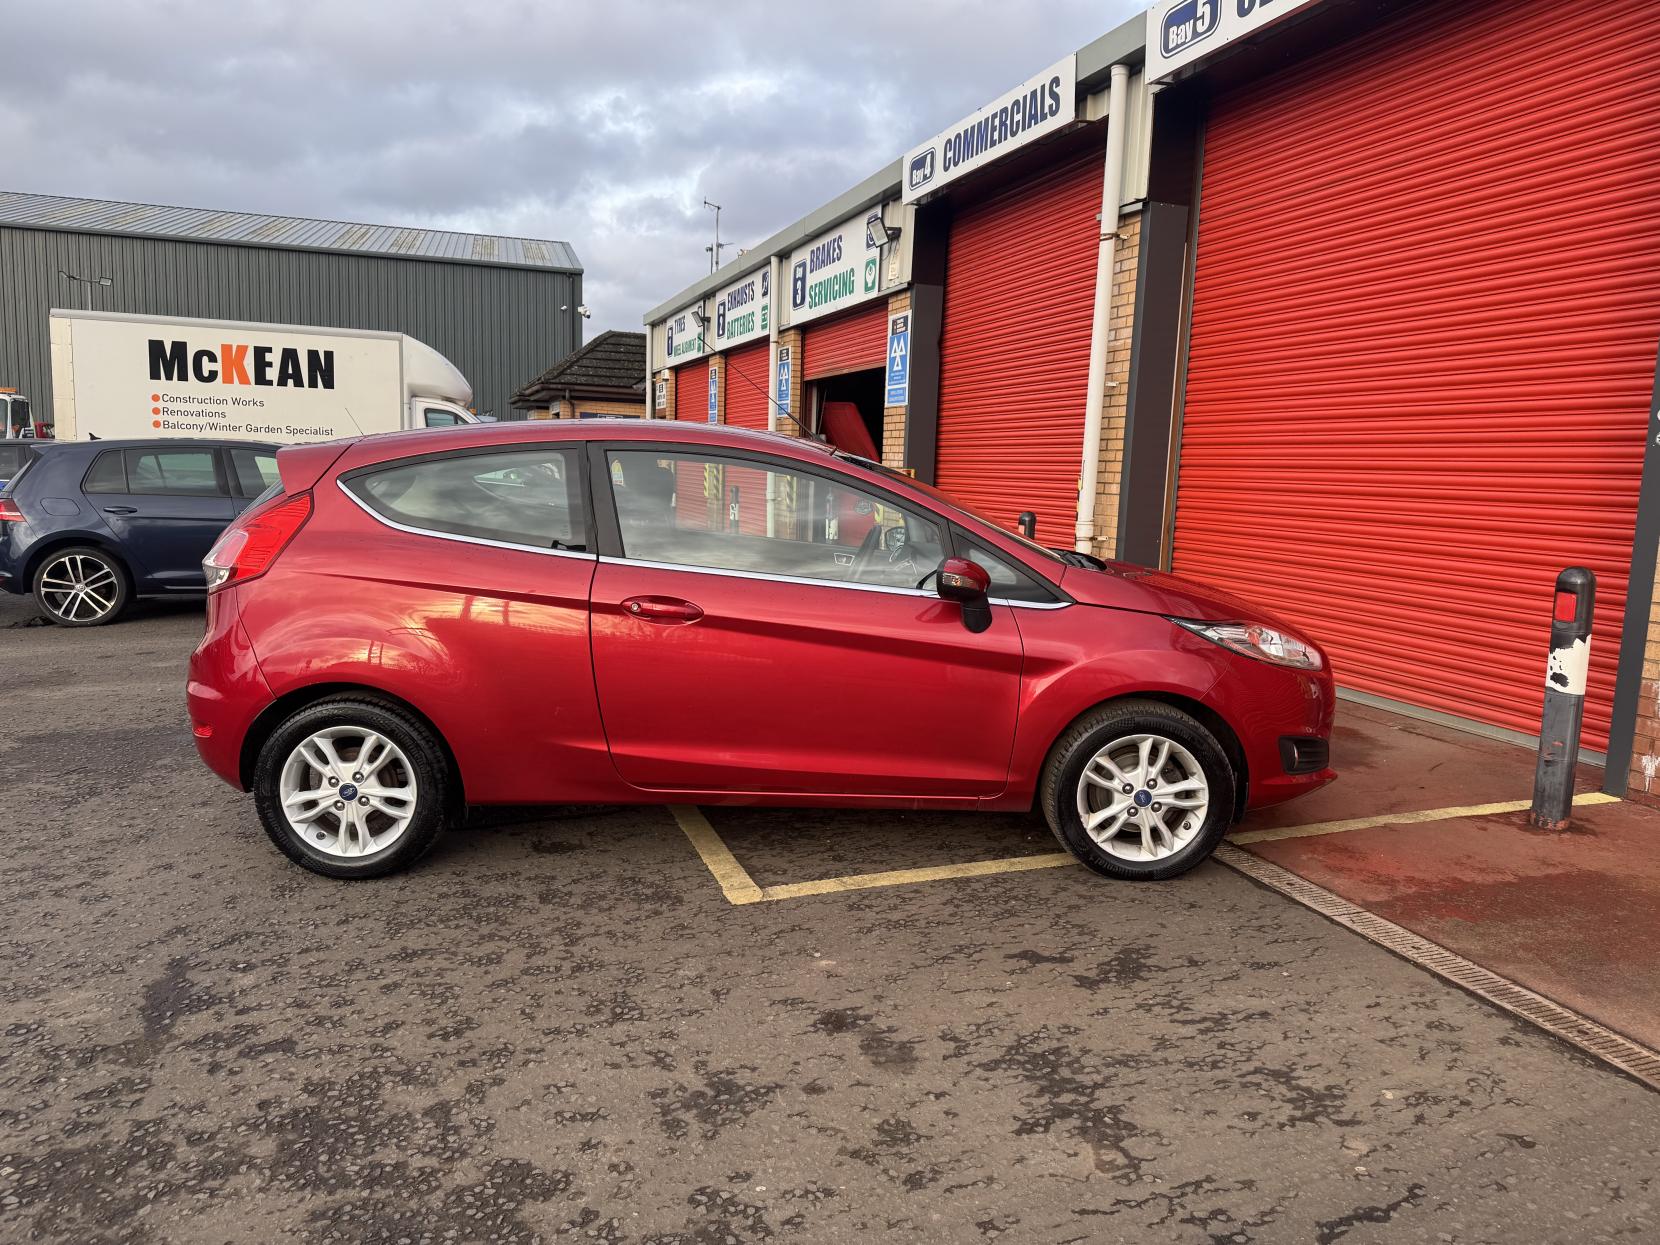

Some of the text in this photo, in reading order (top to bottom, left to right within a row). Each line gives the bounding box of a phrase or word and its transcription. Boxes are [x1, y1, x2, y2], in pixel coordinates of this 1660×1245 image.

[1168, 18, 1193, 49] Bay
[1196, 0, 1211, 33] 5
[943, 75, 1061, 172] COMMERCIALS
[924, 153, 931, 178] 4
[809, 234, 843, 274] BRAKES
[727, 280, 755, 312] EXHAUSTS
[796, 280, 802, 305] 3
[808, 267, 855, 310] SERVICING
[719, 315, 724, 335] 2
[727, 311, 755, 341] BATTERIES
[148, 339, 335, 390] McKEAN
[161, 393, 265, 408] Construction Works
[162, 407, 227, 419] Renovations
[162, 420, 334, 437] Balcony/Winter Garden Specialist
